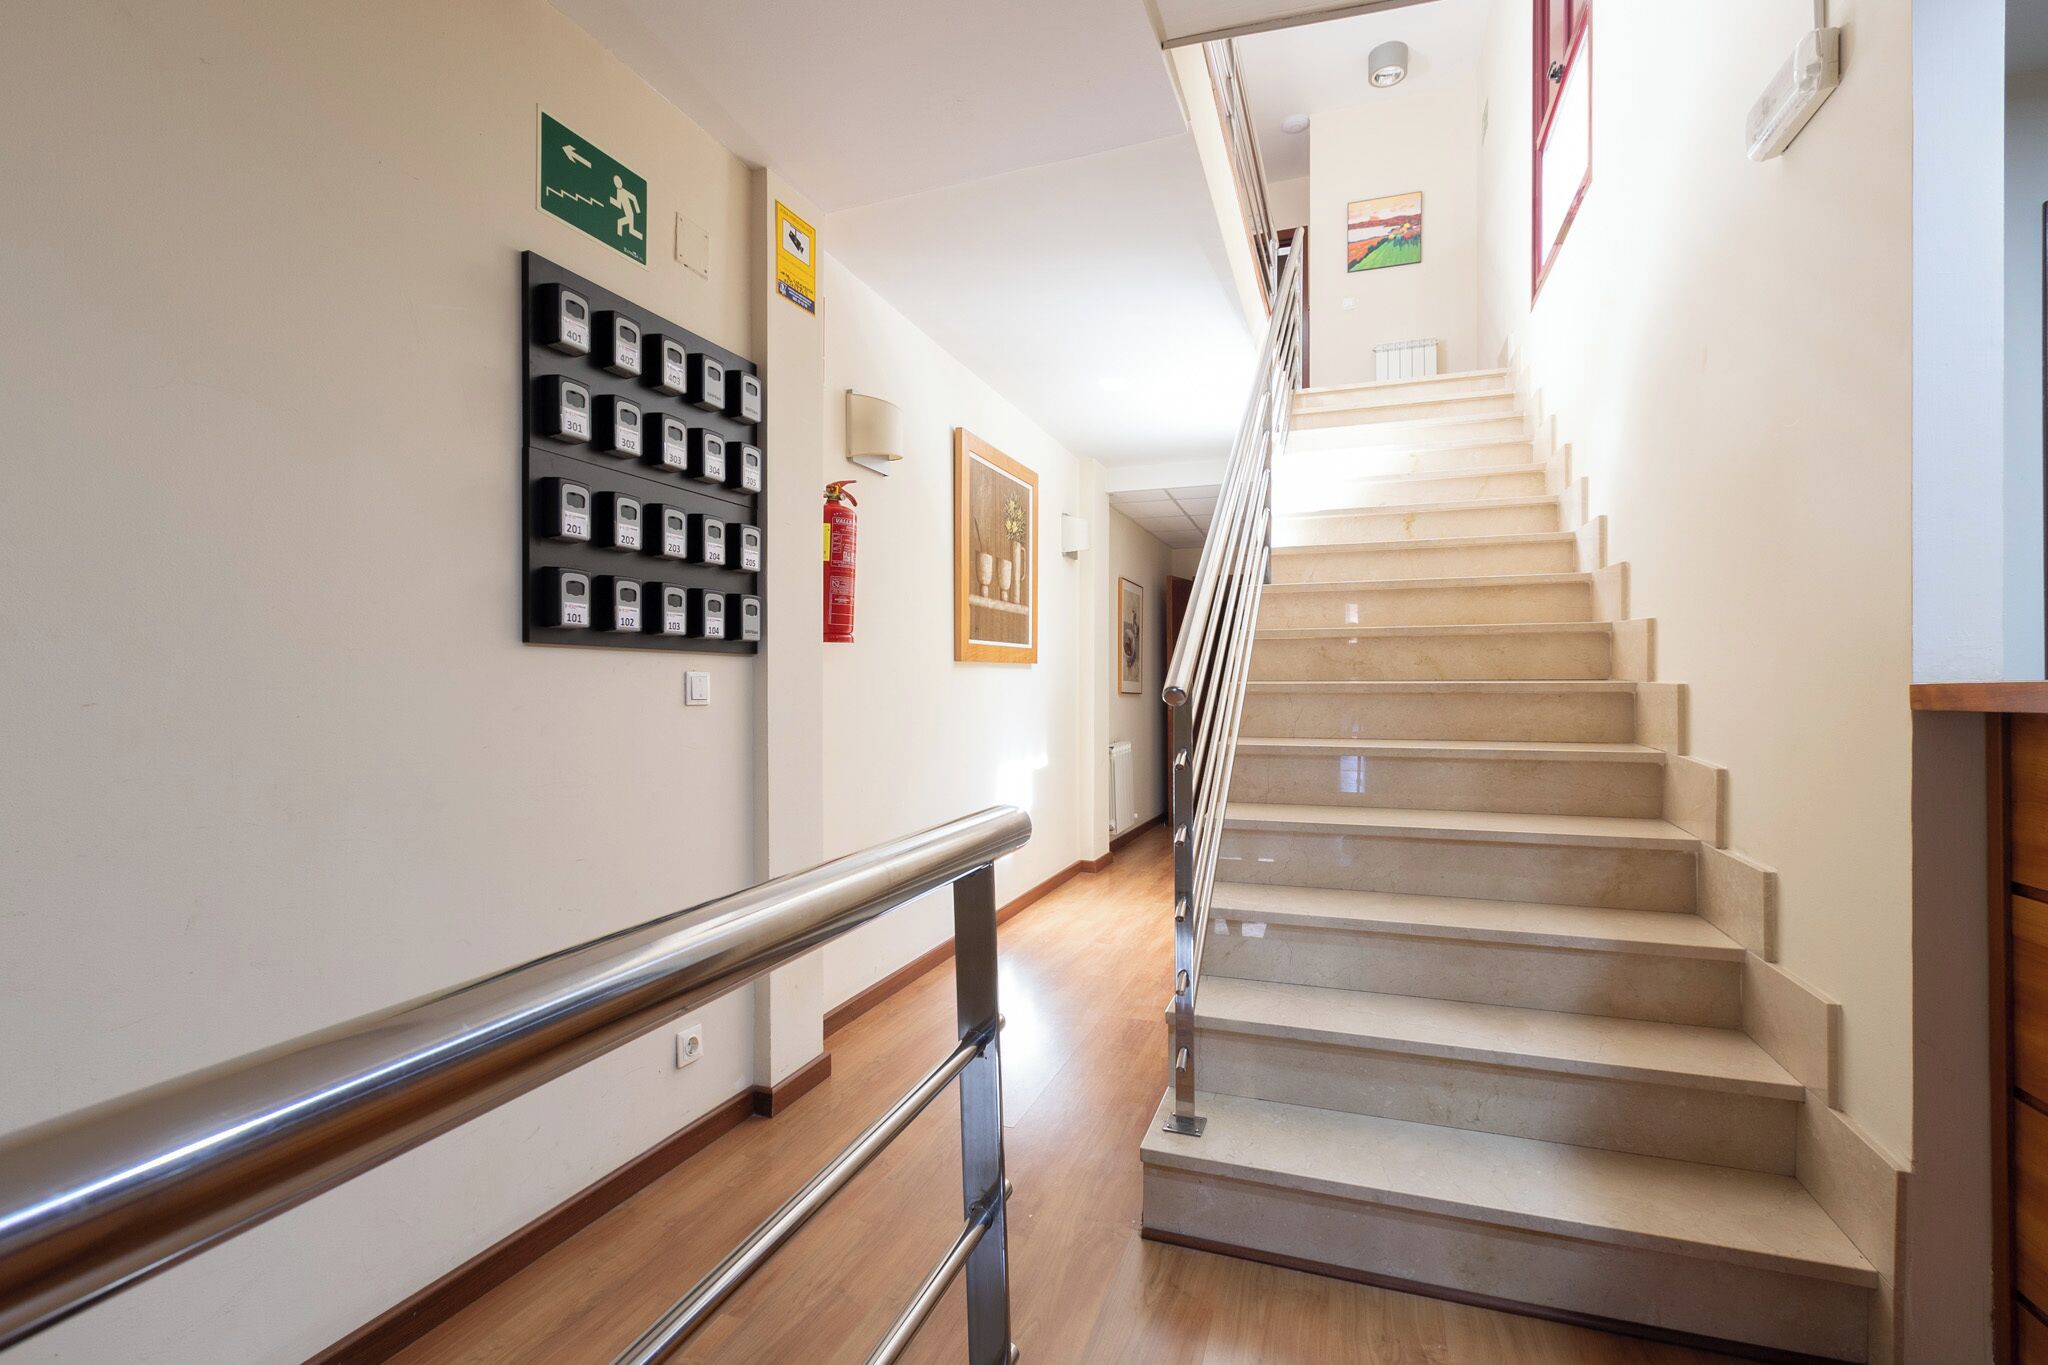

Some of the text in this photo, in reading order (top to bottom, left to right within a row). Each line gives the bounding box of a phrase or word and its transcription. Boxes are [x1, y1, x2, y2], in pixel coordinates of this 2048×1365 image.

[566, 330, 583, 344] 401
[620, 354, 635, 367] 402
[668, 374, 681, 386] 403
[567, 420, 583, 433] 301
[621, 438, 635, 450] 302
[669, 454, 682, 465] 303
[709, 465, 720, 475] 304
[746, 477, 756, 487] 305
[566, 523, 582, 535] 201
[620, 535, 635, 545] 202
[668, 543, 681, 553] 203
[709, 551, 720, 561] 204
[745, 558, 756, 567] 205
[567, 613, 582, 623] 101
[620, 617, 635, 627] 102
[668, 621, 681, 631] 103
[708, 626, 720, 635] 104
